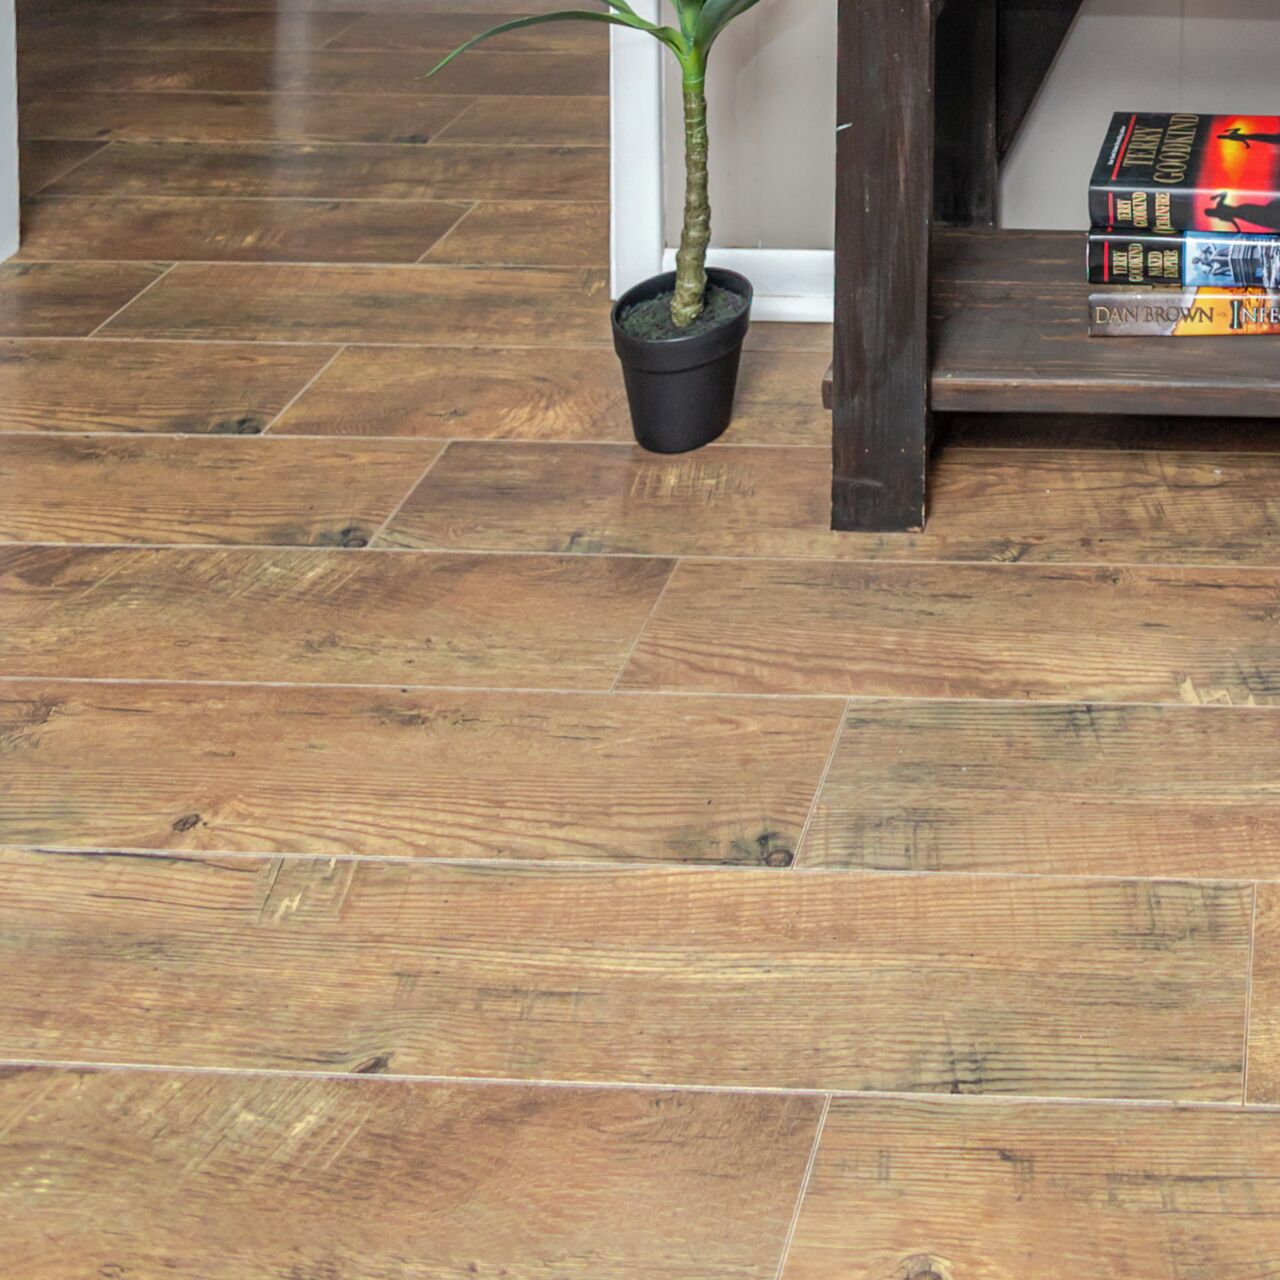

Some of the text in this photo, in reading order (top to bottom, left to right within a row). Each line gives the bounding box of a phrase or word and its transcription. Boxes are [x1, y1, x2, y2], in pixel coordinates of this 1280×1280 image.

[1123, 124, 1163, 167] TERRY
[1153, 114, 1200, 184] GOODKIND
[1117, 198, 1132, 221] TERRY
[1132, 191, 1148, 228] GOODKIND
[1113, 250, 1128, 275] TERRY
[1128, 243, 1144, 282] GOODKIND
[1095, 306, 1138, 324] DAN
[1142, 306, 1214, 324] BROWN
